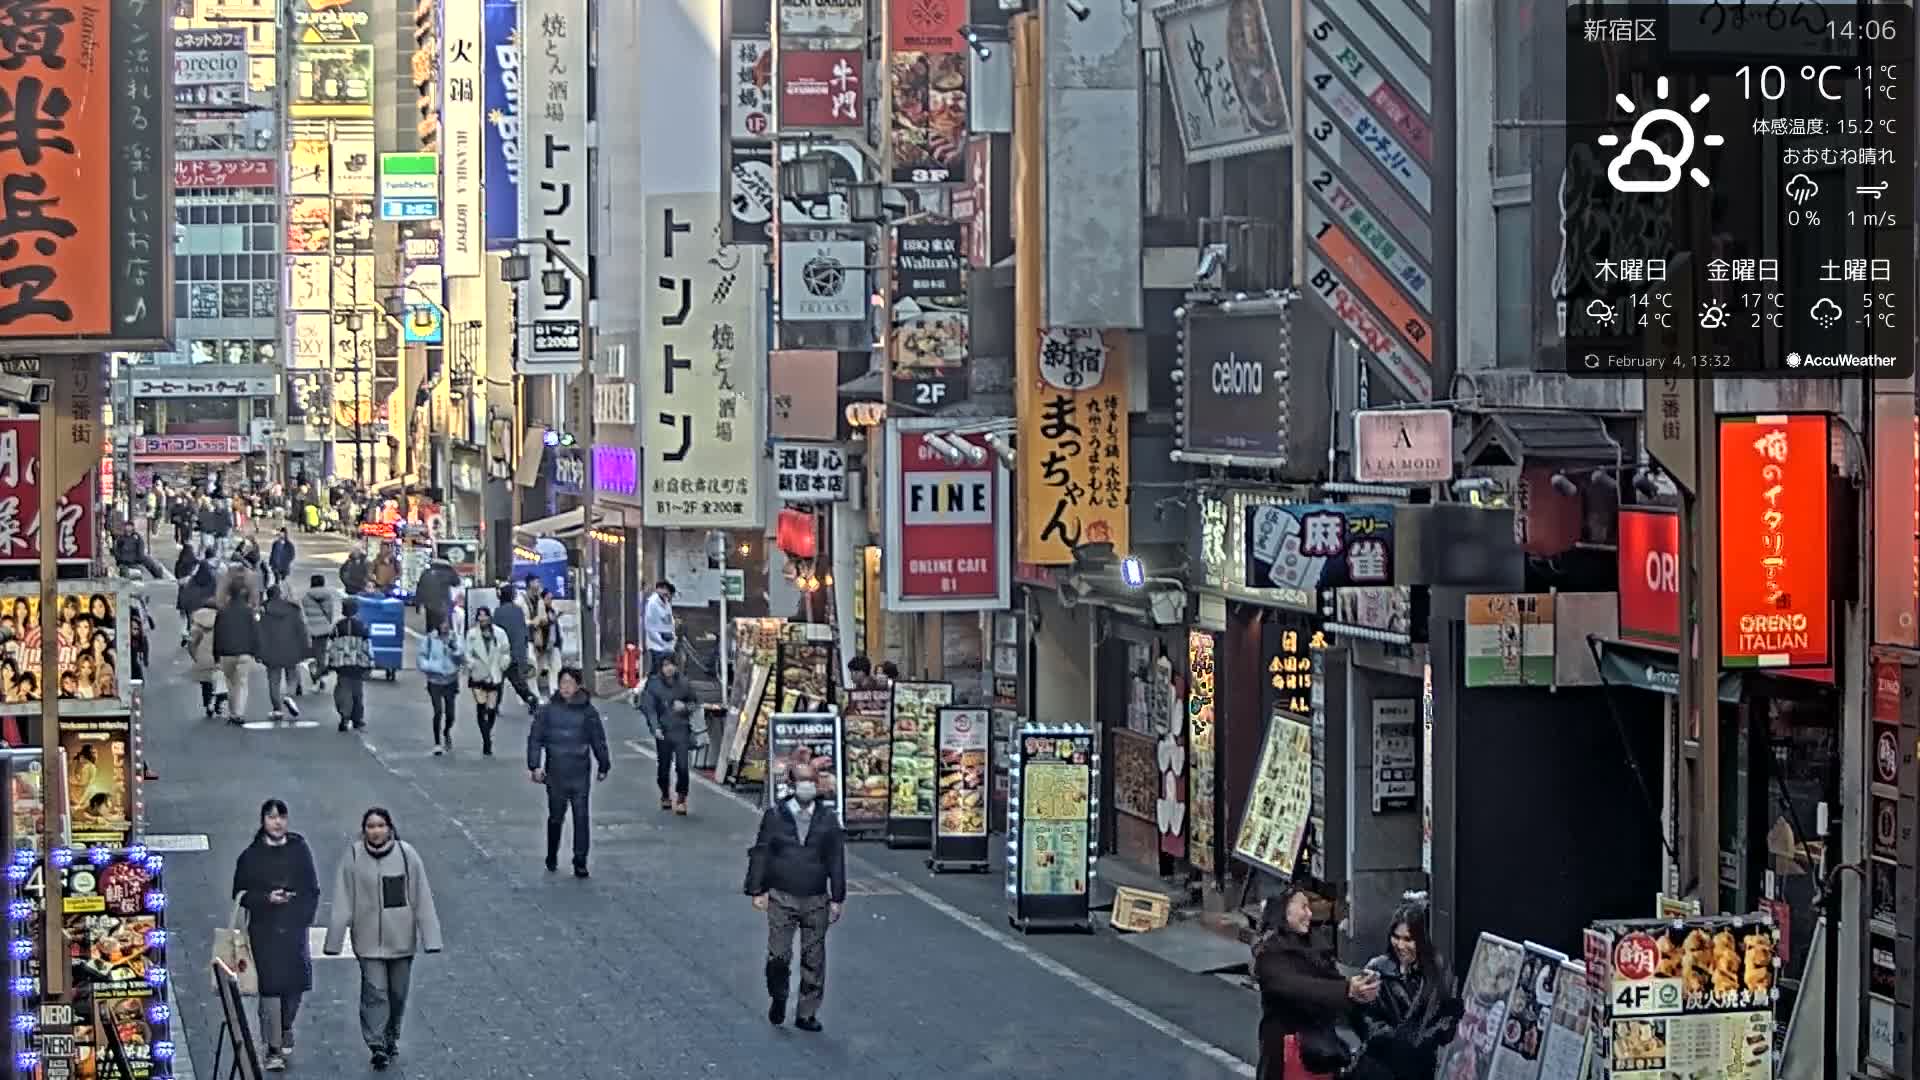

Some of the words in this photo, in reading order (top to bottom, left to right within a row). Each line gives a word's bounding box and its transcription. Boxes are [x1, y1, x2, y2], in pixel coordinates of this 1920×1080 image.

[1313, 21, 1334, 42] 5
[449, 38, 473, 102] 火鍋
[541, 13, 568, 122] 焼とん酒場
[830, 58, 859, 119] 牛門
[1313, 72, 1333, 91] 4
[1313, 121, 1334, 142] 3
[911, 168, 949, 182] 3F
[1312, 171, 1333, 192] 2
[540, 134, 570, 310] トントン
[1315, 221, 1332, 240] 1
[901, 255, 958, 270] Walton's
[1311, 267, 1339, 297] B1
[659, 208, 691, 462] トントン
[711, 323, 736, 443] 焼とん酒場
[1212, 352, 1263, 394] celona
[916, 383, 946, 404] 2F
[1392, 421, 1412, 448] A
[778, 448, 845, 471] 酒場心
[1040, 394, 1085, 547] まっちゃん
[778, 474, 843, 493] 新宿本店
[910, 484, 986, 513] FINE
[1350, 519, 1388, 533] フリー
[909, 558, 953, 573] ONLINE
[957, 558, 988, 573] CAFE
[941, 577, 957, 592] B1
[1740, 614, 1808, 633] ORENO
[1738, 633, 1809, 651] ITALIAN
[775, 723, 833, 735] GYUMON
[1616, 986, 1650, 1008] 4F
[41, 1005, 72, 1025] NERO
[43, 1035, 75, 1056] NERO
